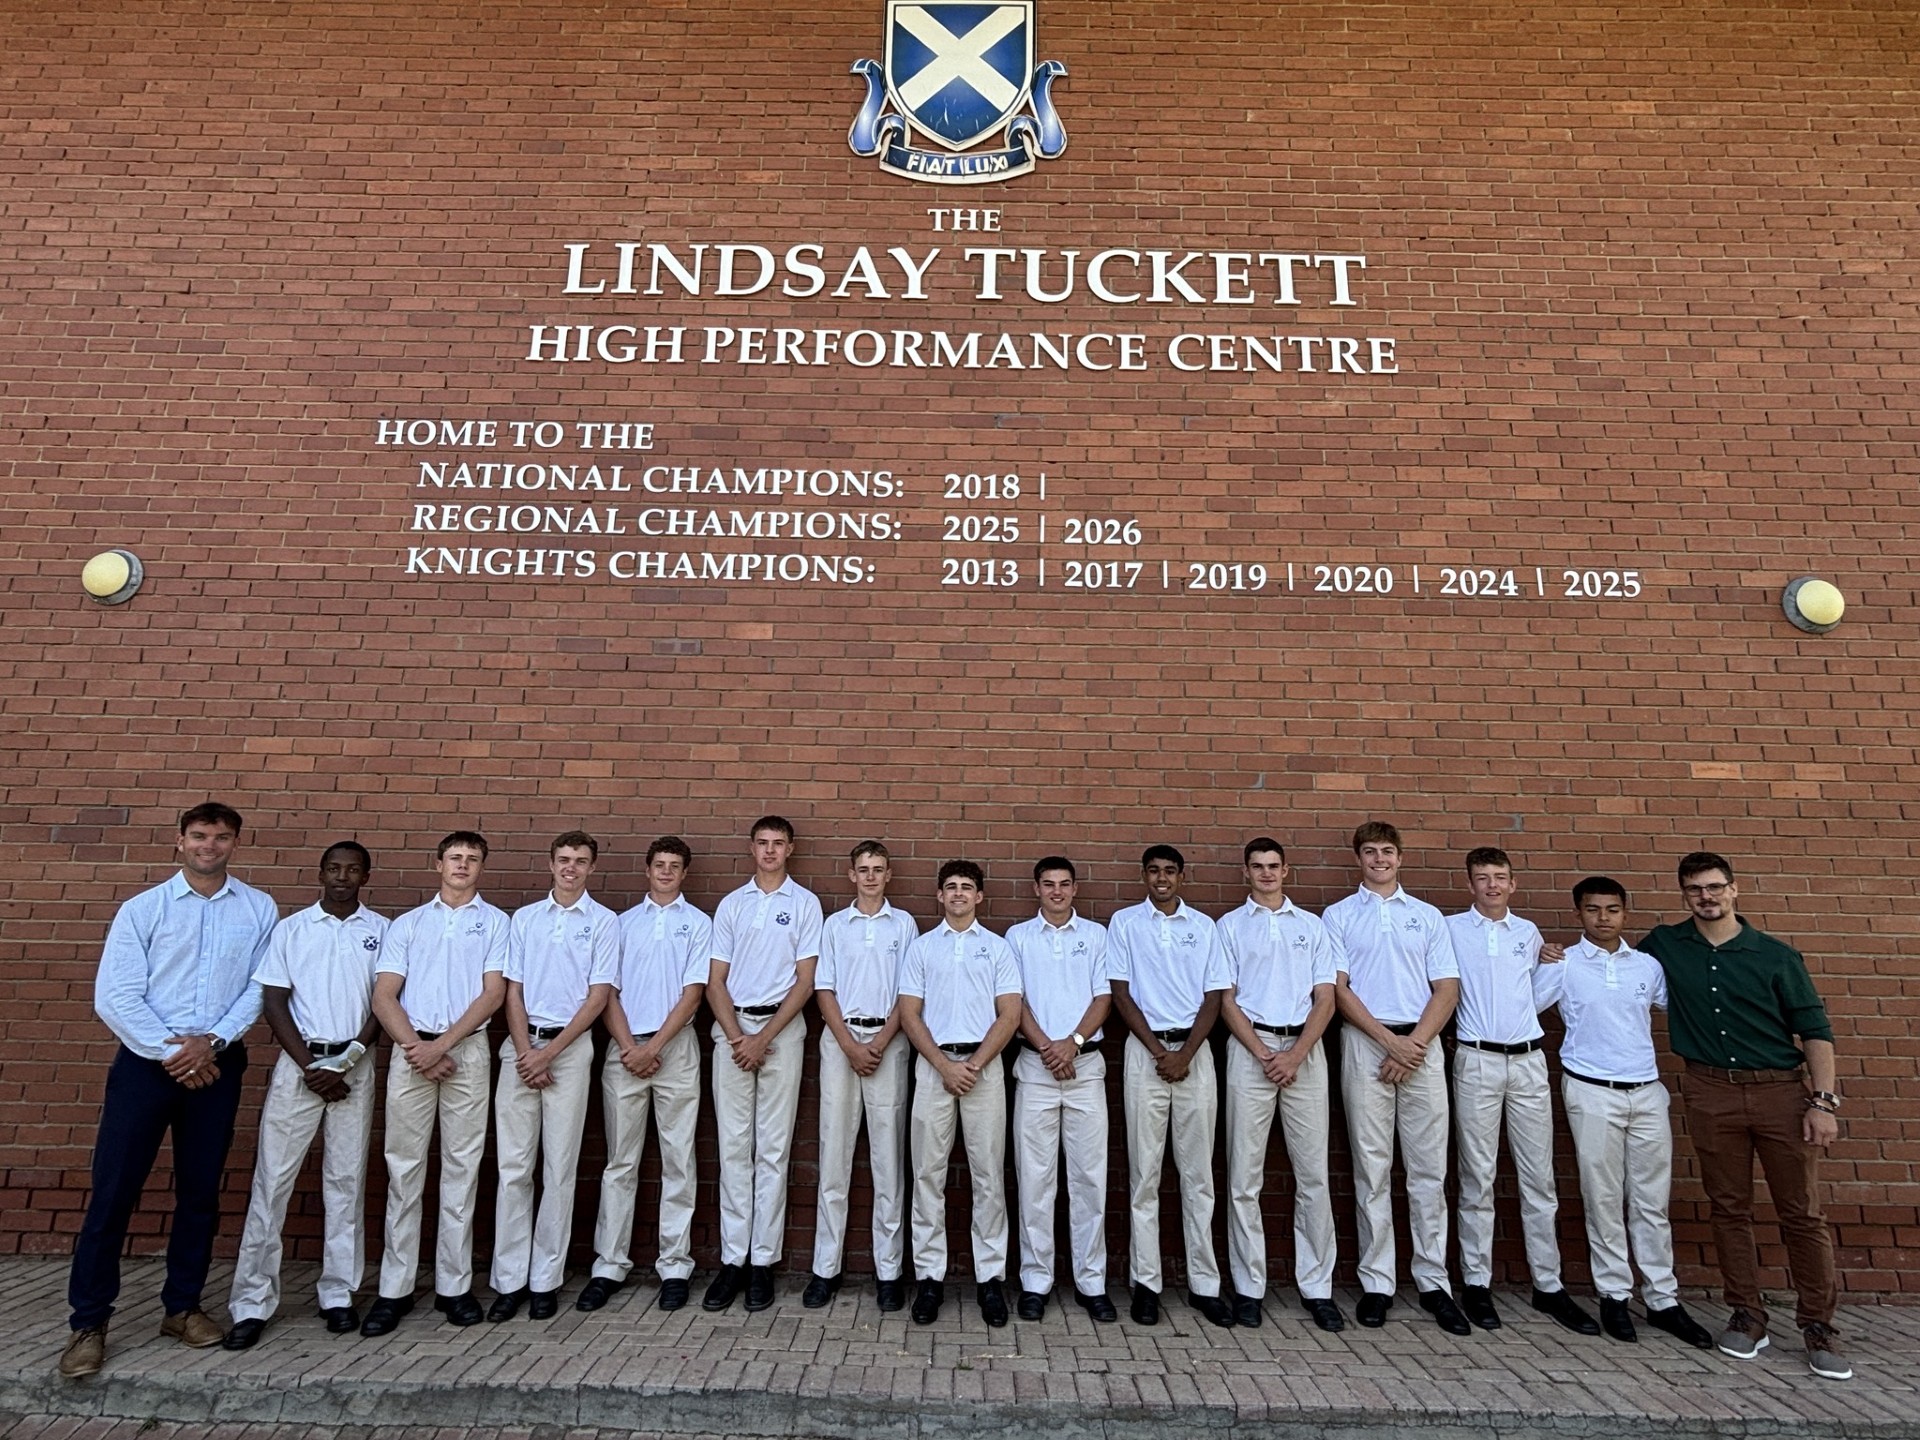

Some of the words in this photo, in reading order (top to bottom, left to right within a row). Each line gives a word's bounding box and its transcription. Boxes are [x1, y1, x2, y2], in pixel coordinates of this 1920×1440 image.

[906, 154, 954, 174] FIAT
[964, 155, 1009, 174] LUX
[928, 208, 1001, 232] THE
[562, 243, 941, 300] LINDSAY
[964, 247, 1367, 306] TUCKETT
[525, 324, 687, 363] HIGH
[701, 326, 1148, 371] PERFORMANCE
[1168, 333, 1399, 374] CENTRE
[375, 419, 498, 447] HOME
[509, 421, 564, 449] TO
[576, 422, 655, 450] THE
[416, 461, 632, 492] NATIONAL
[642, 466, 904, 498] CHAMPIONS:
[943, 473, 1020, 500] 2018
[411, 504, 626, 534] REGIONAL
[638, 508, 902, 541] CHAMPIONS:
[942, 515, 1020, 543] 2025
[1064, 518, 1142, 546] 2026
[404, 546, 597, 579] KNIGHTS
[608, 550, 875, 584] CHAMPIONS:
[941, 558, 1019, 587] 2013
[1064, 560, 1144, 589] 2017
[1188, 563, 1268, 591] 2019
[1314, 565, 1394, 594] 2020
[1440, 568, 1520, 596] 2024
[1563, 570, 1641, 598] 2025
